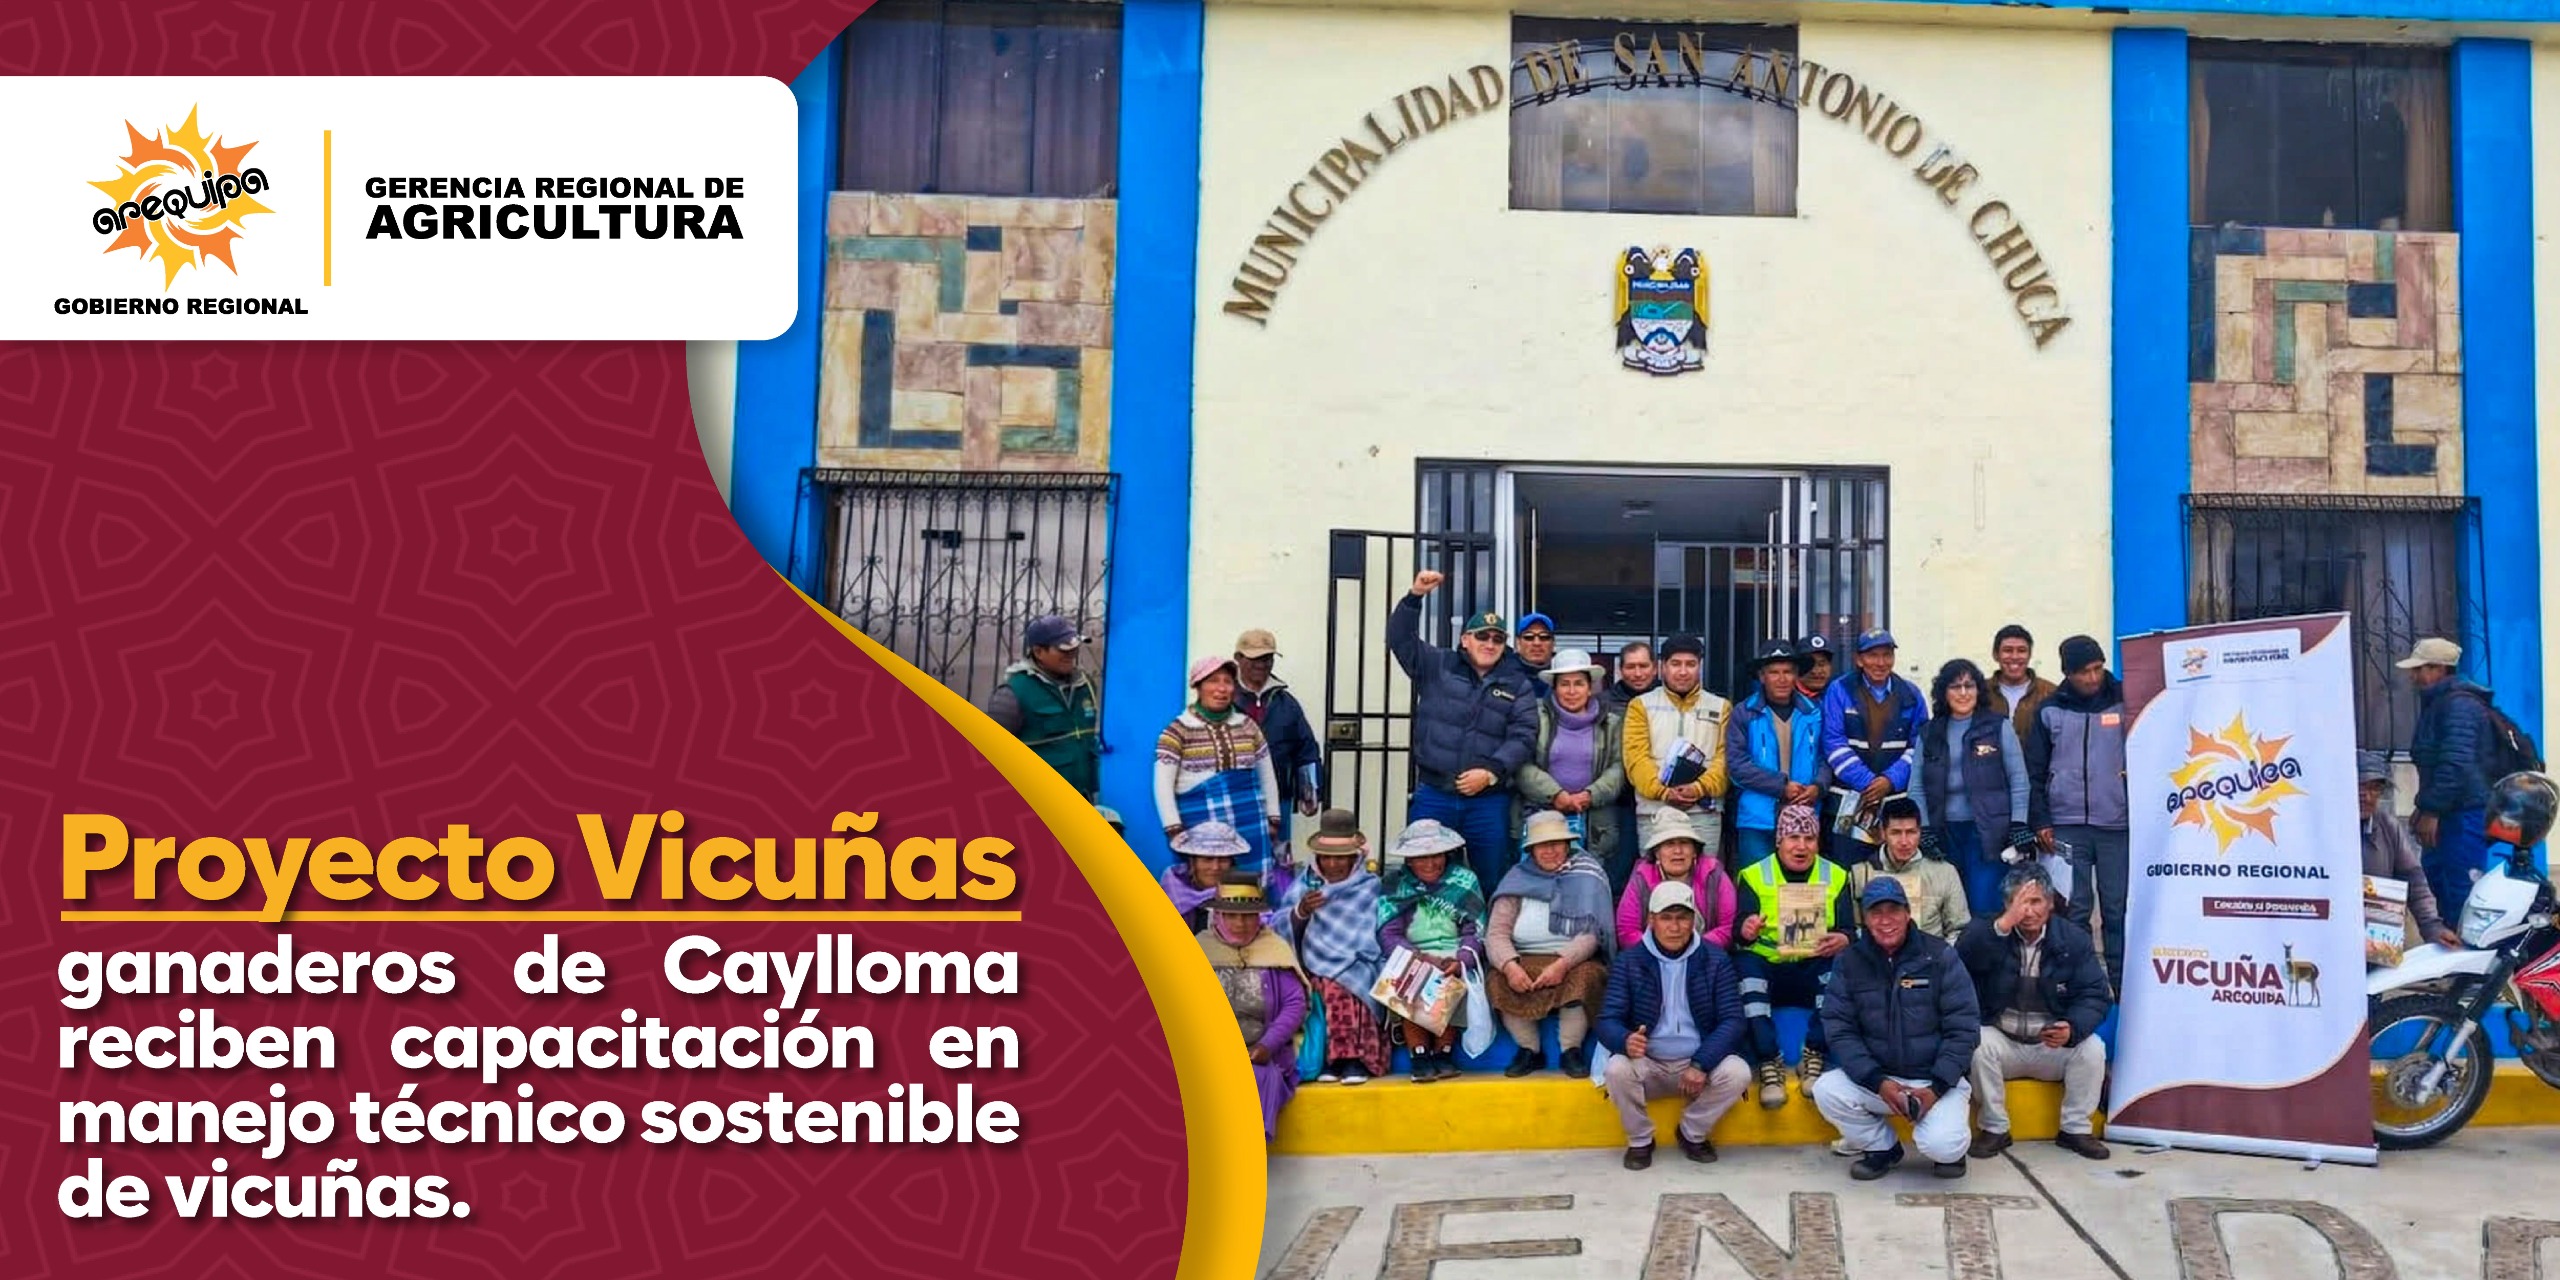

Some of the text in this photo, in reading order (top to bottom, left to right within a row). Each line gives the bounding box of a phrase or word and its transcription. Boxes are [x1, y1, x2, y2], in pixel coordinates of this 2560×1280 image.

[1223, 64, 1504, 328] MUNICIPALIDAD
[1524, 39, 1591, 97] DE
[1613, 30, 1706, 88] SAN
[1728, 44, 1923, 158] ANTONIO
[1970, 200, 2072, 346] CHUCA
[2237, 864, 2330, 879] REGIONAL
[2152, 953, 2284, 990] VICUÑA
